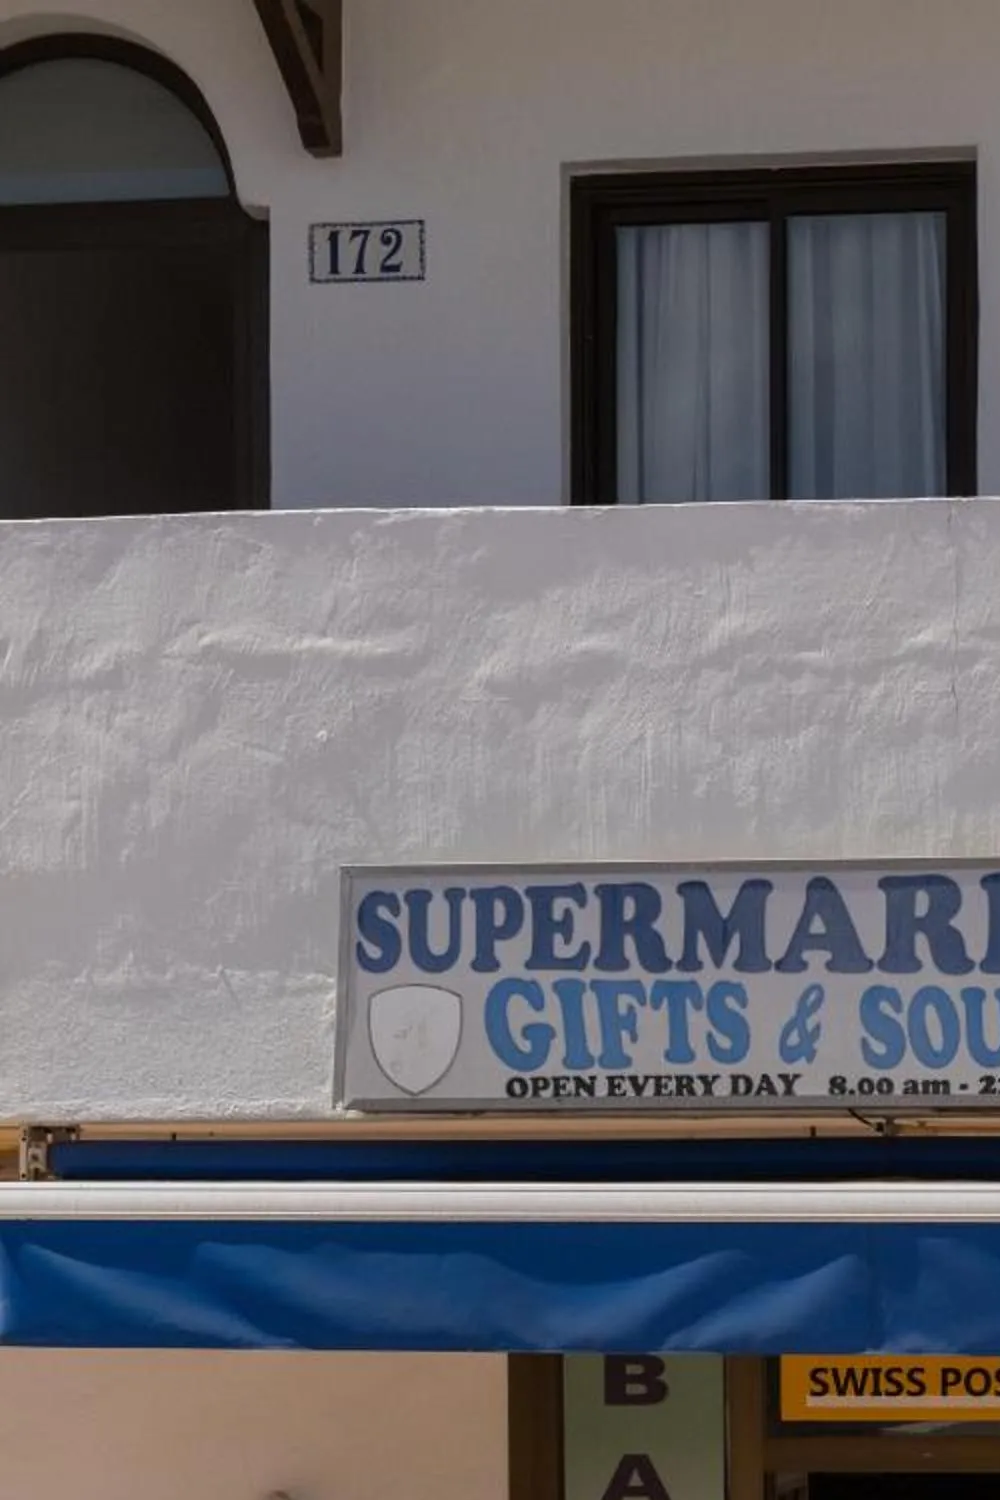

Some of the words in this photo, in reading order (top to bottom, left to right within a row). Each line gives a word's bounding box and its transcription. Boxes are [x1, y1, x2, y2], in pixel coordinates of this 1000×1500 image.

[326, 227, 404, 275] 172
[484, 976, 750, 1072] GIFTS
[777, 983, 827, 1065] &
[505, 1075, 598, 1099] OPEN
[606, 1074, 720, 1098] EVERY
[730, 1073, 803, 1097] DAY
[827, 1075, 895, 1096] 8.00
[902, 1078, 951, 1096] am
[808, 1366, 927, 1398] SWISS
